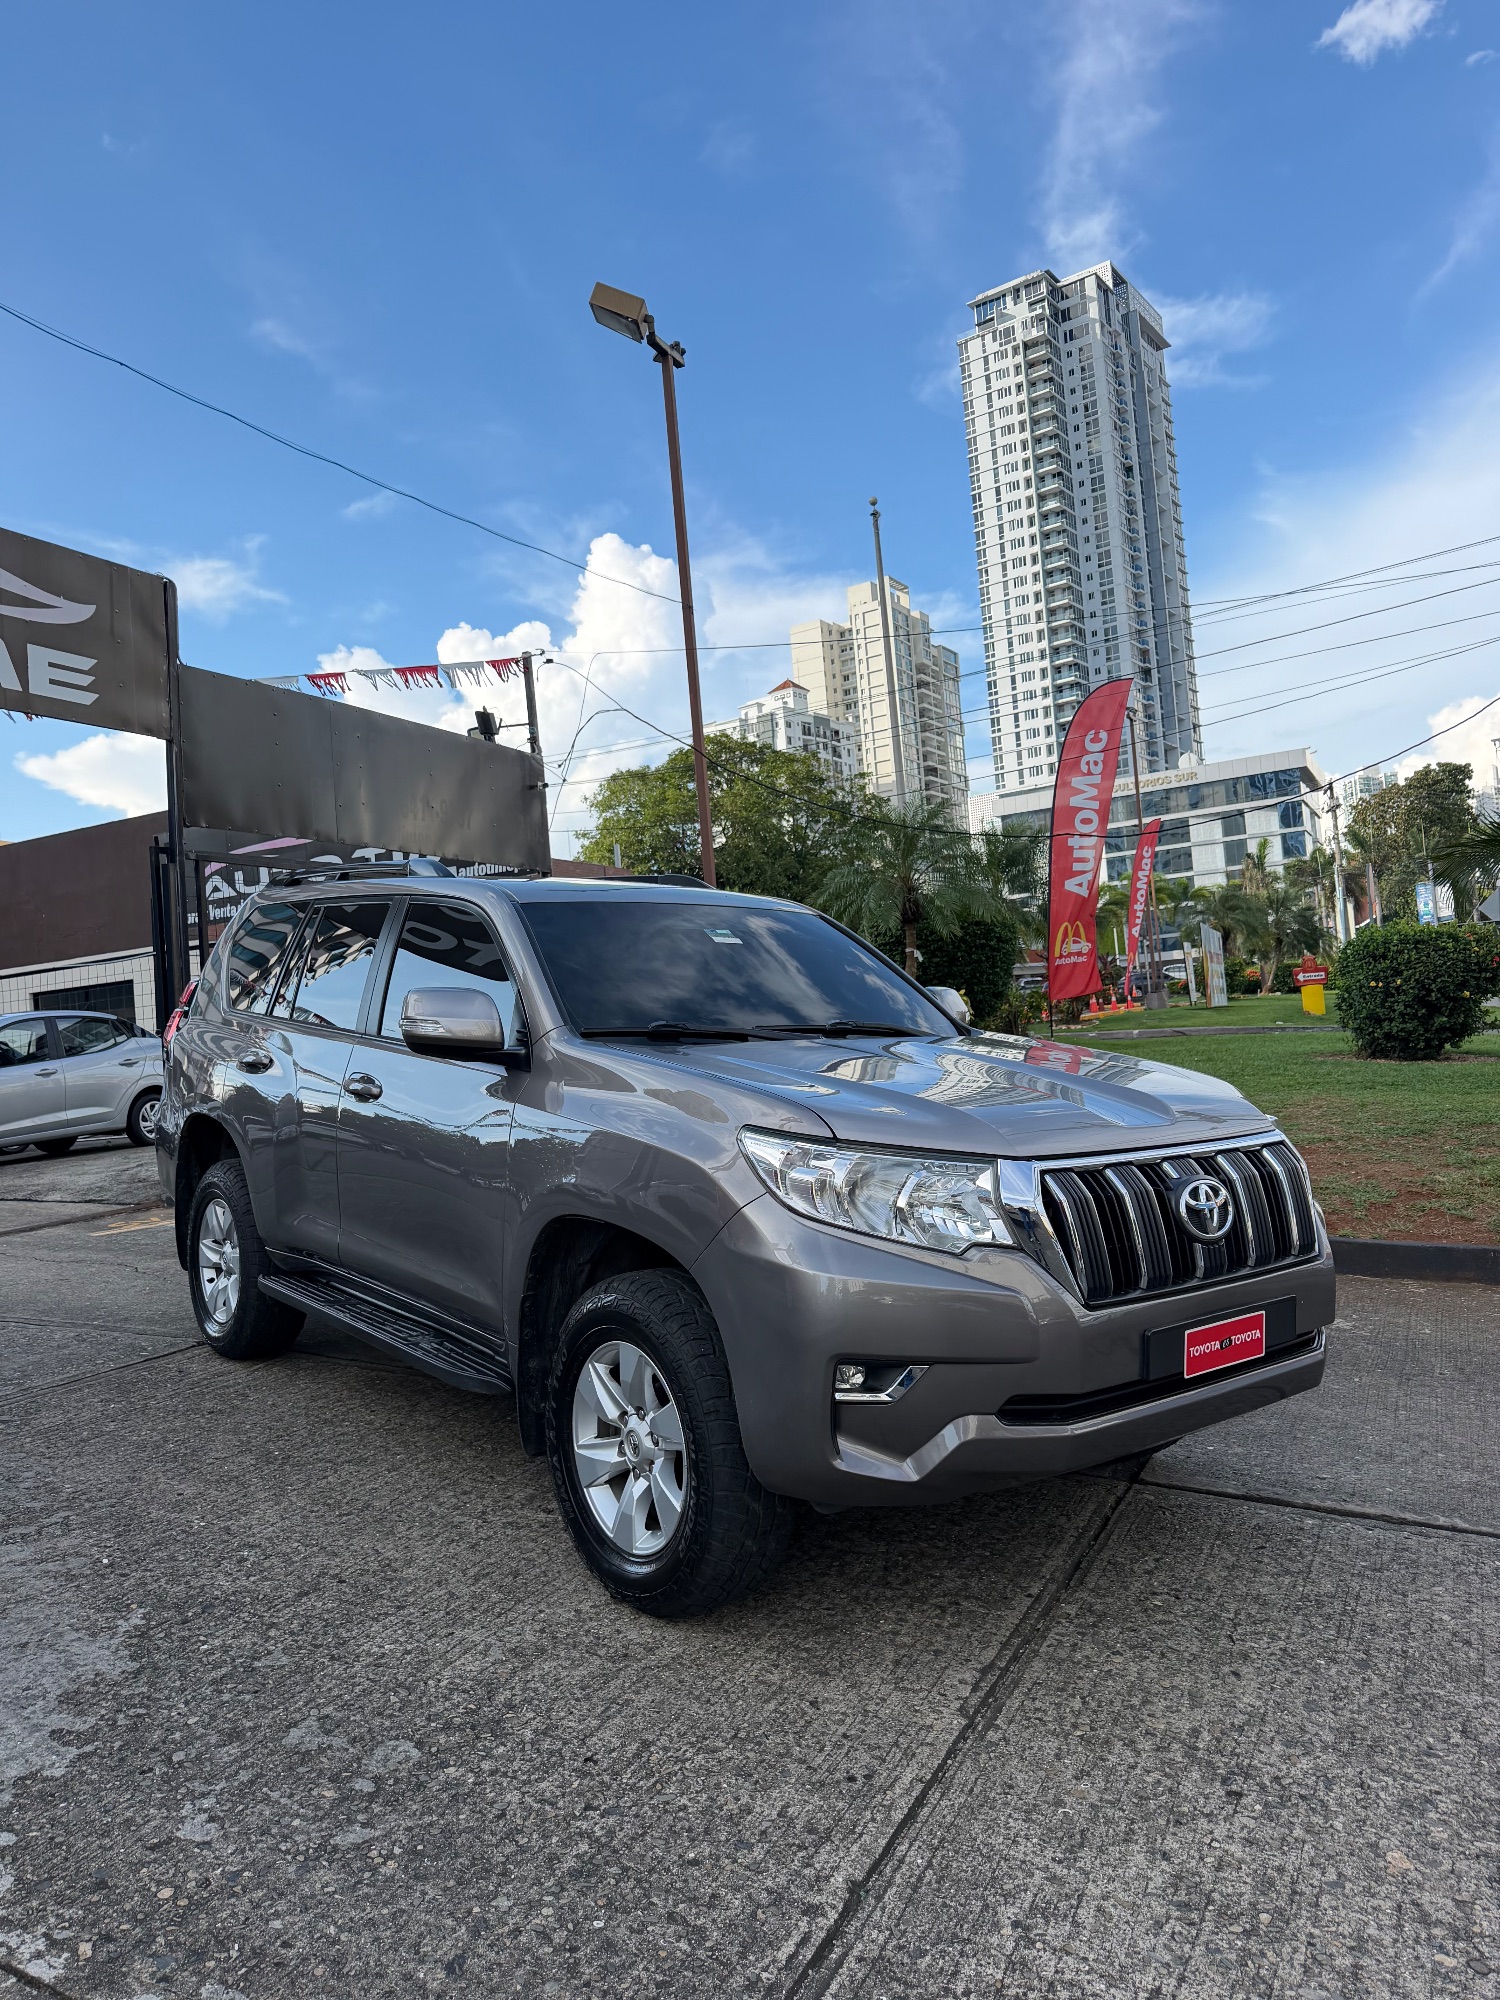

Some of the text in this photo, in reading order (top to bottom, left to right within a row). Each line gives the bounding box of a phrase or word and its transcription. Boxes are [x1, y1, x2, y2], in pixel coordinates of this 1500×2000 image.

[1174, 771, 1198, 782] SUR
[1064, 729, 1108, 898] AutoMac
[1131, 845, 1152, 938] AutoMac
[1055, 955, 1088, 966] AutoMac
[1189, 1329, 1261, 1357] TOYOTA es TOYOTA
